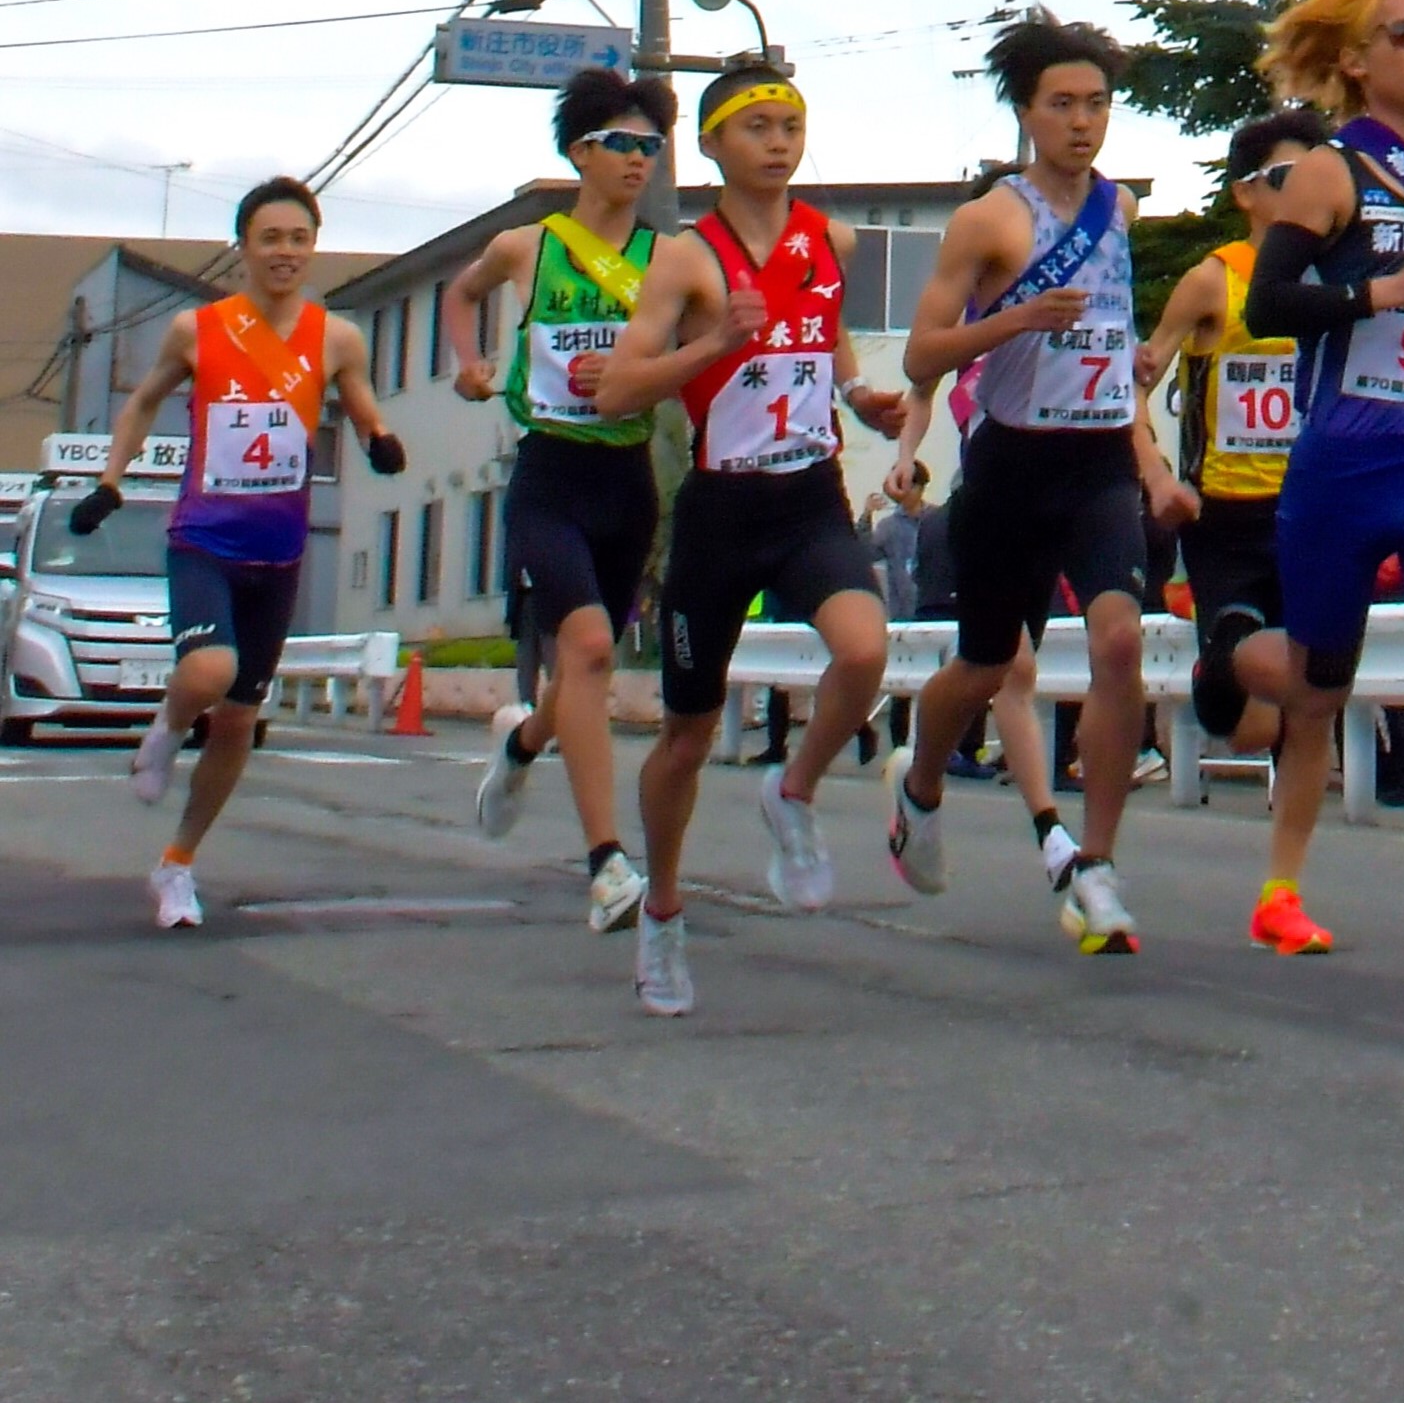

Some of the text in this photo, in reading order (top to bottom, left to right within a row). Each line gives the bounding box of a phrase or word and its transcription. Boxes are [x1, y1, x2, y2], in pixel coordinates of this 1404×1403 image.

[551, 327, 615, 352] 北村山
[742, 360, 817, 387] 米沢
[1080, 356, 1112, 401] 7
[229, 407, 289, 428] 上山
[766, 393, 789, 442] 1
[1238, 387, 1291, 431] 10
[242, 432, 275, 470] 4
